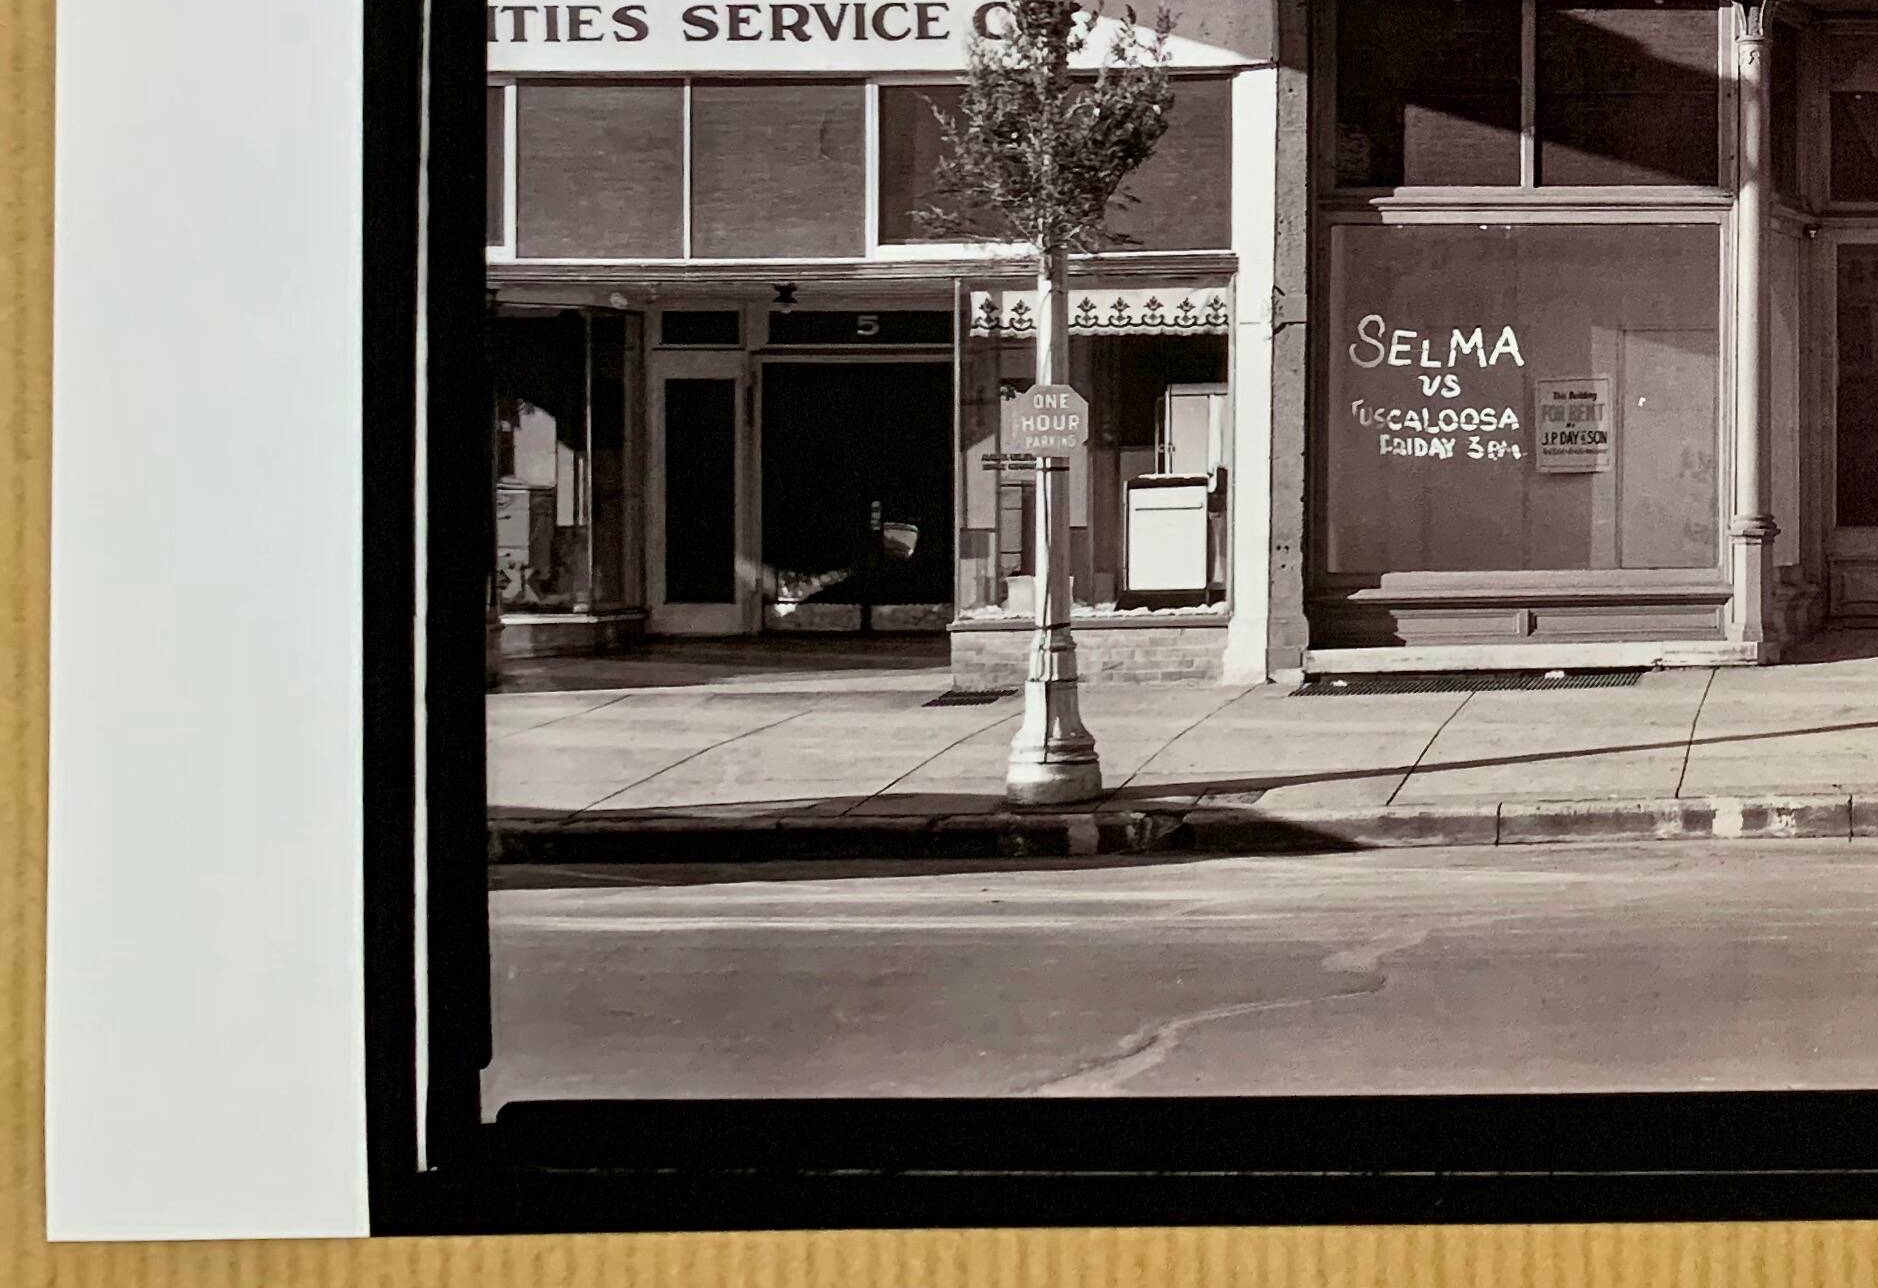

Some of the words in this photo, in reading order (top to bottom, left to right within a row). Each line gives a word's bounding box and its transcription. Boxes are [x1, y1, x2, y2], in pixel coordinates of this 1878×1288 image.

[681, 1, 950, 43] SERVICE
[857, 315, 880, 336] 5
[1349, 313, 1526, 369] SELMA
[1033, 393, 1070, 409] ONE
[1021, 414, 1080, 432] HOUR
[1351, 399, 1520, 434] TUSCALOOSA
[1025, 434, 1077, 449] PARKING
[1379, 434, 1456, 460] FRIDAY
[1466, 435, 1485, 460] 3
